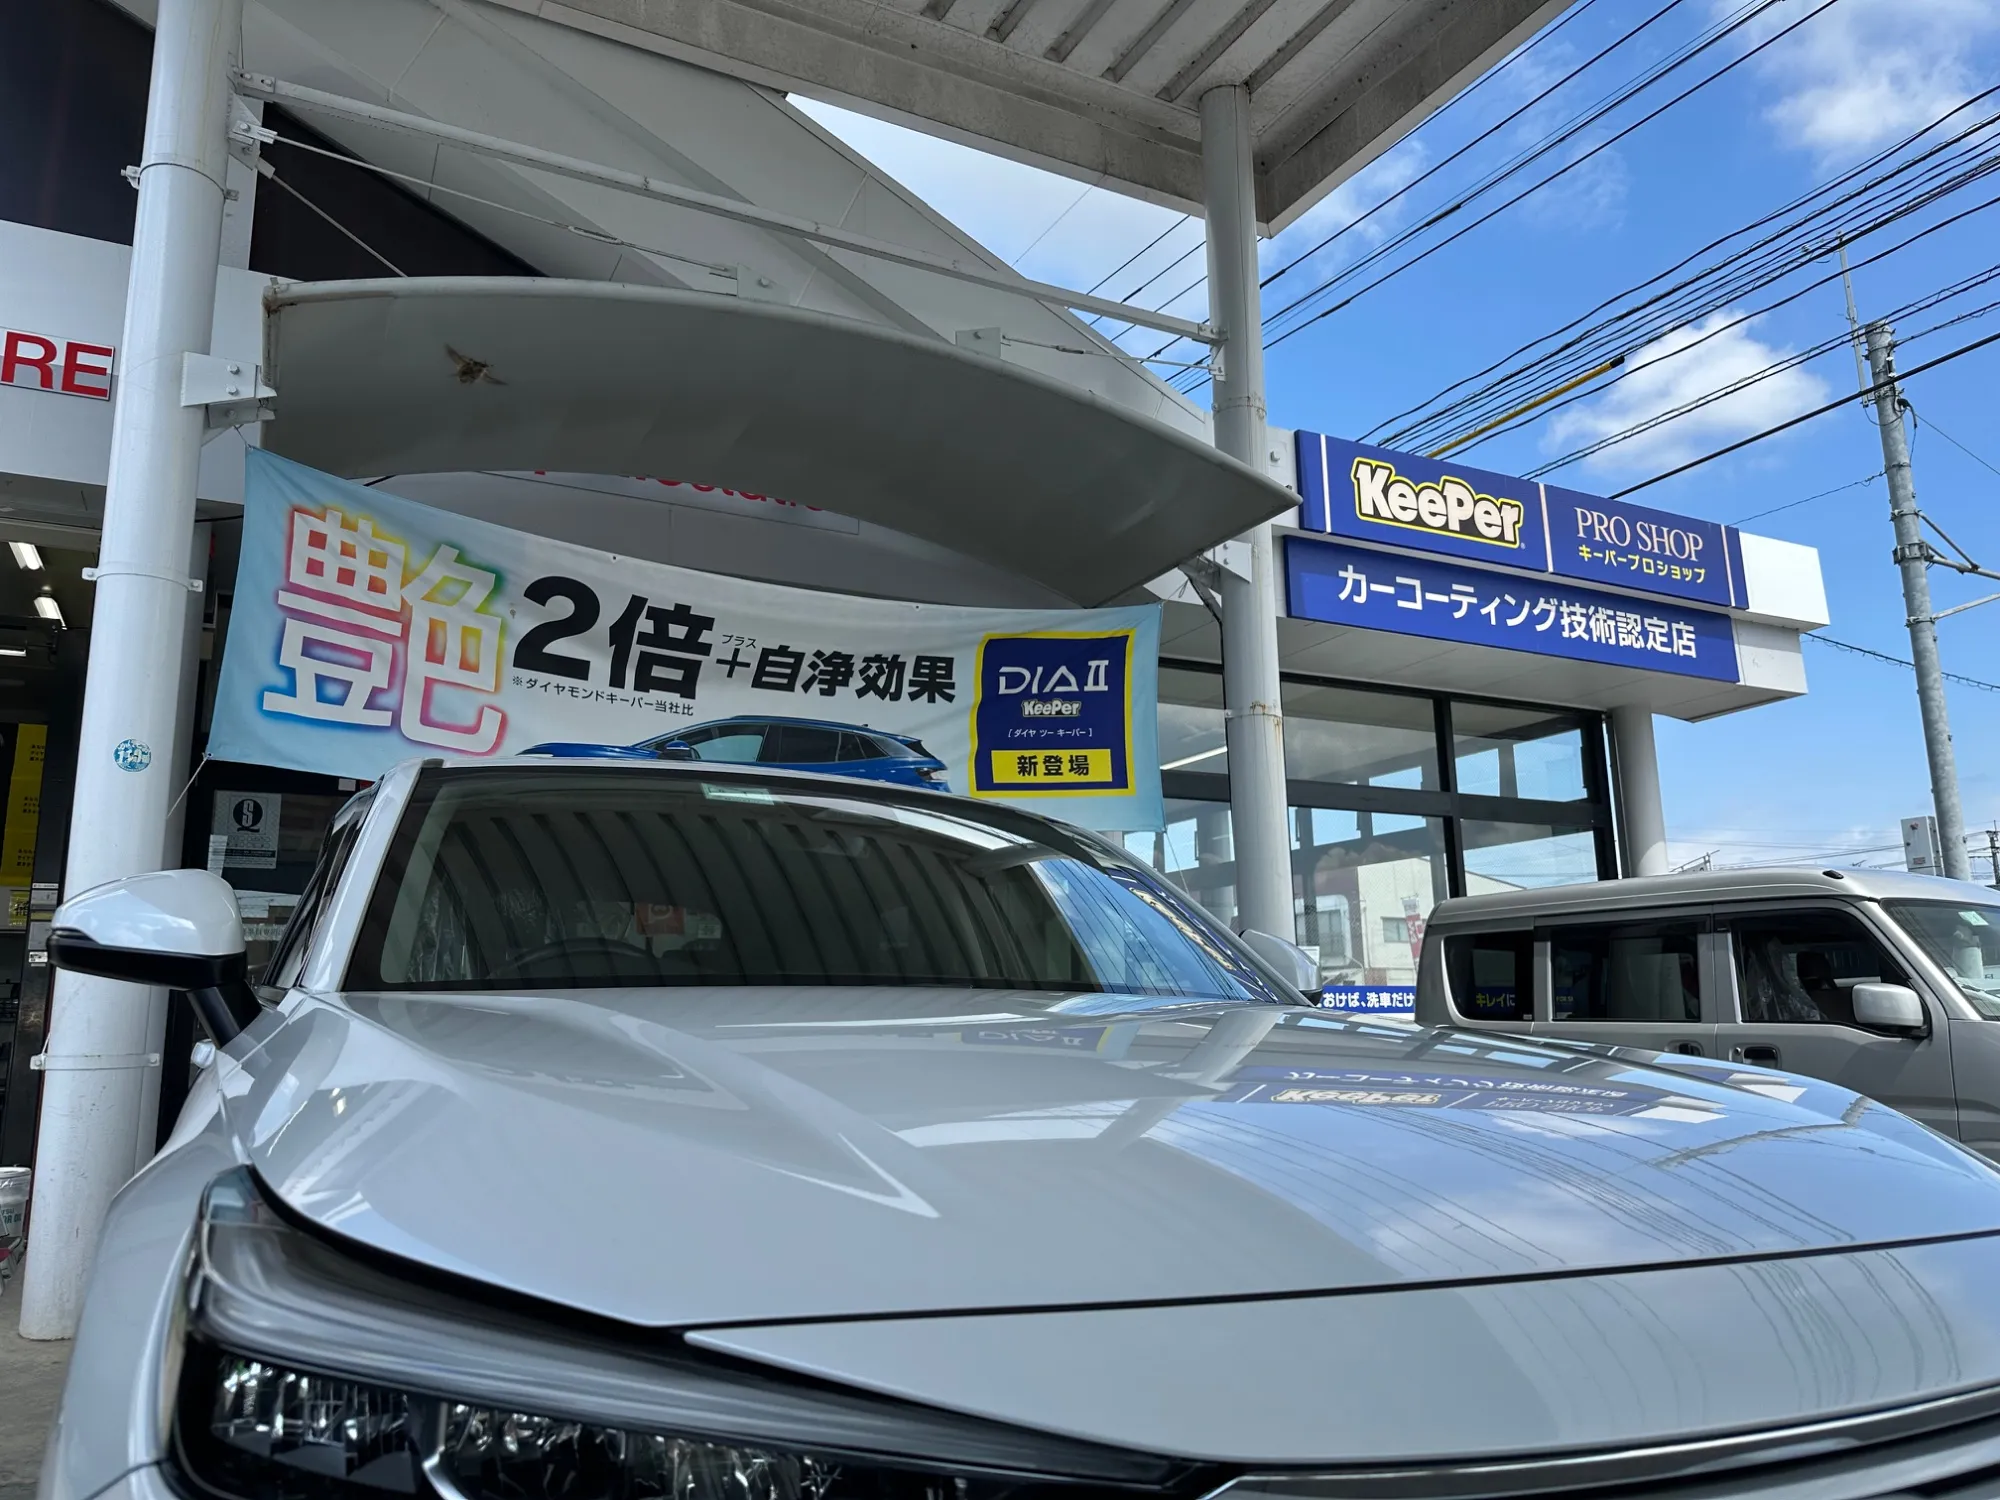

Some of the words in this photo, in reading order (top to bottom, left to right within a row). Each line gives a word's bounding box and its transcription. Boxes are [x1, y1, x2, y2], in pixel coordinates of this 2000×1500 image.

[1, 331, 113, 398] RE
[1354, 460, 1522, 544] KeePer
[1574, 507, 1631, 547] PRO
[1636, 520, 1704, 562] SHOP
[1578, 544, 1706, 583] キーパープロショップ
[262, 508, 503, 754] 艶
[1338, 564, 1697, 659] カーコーティング技術認定店
[722, 634, 757, 649] プラス
[1022, 698, 1081, 717] KeePer
[1017, 755, 1090, 777] 新登場
[1316, 992, 1415, 1008] おけば、洗車だけ
